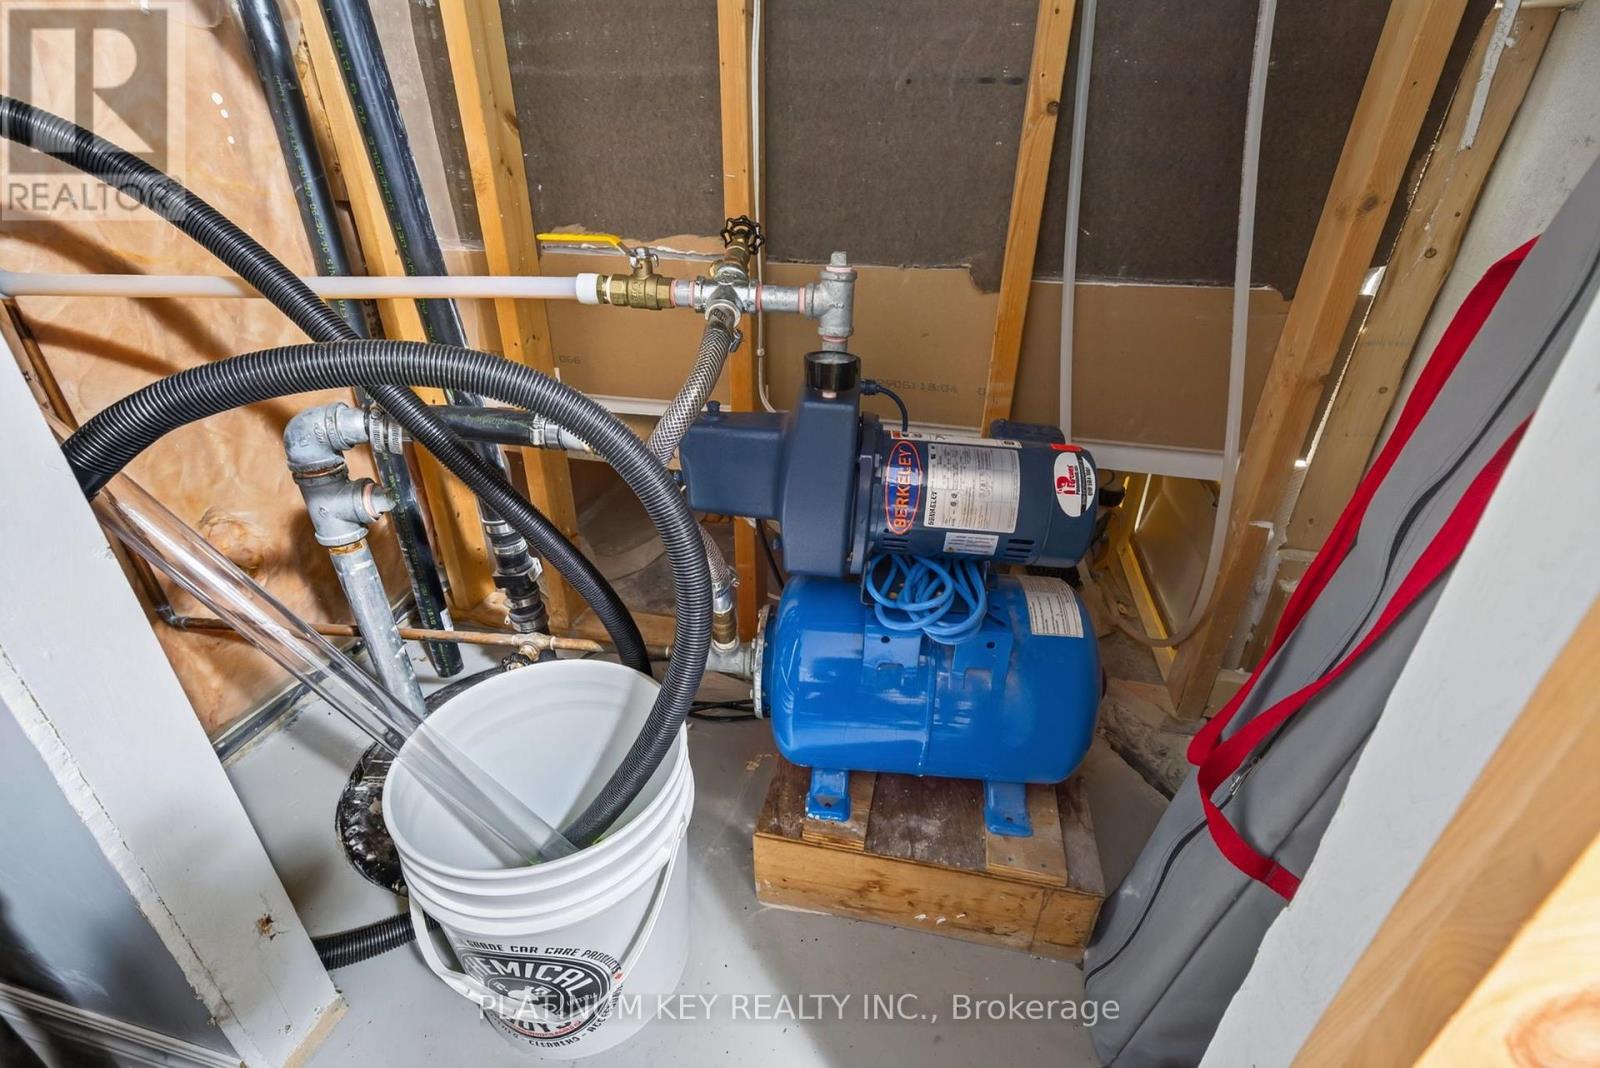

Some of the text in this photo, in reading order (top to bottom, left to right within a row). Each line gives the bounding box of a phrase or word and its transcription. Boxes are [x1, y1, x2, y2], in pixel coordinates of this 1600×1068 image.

[892, 447, 912, 528] BERKELEY
[510, 946, 538, 954] CAR
[544, 947, 579, 956] CARE
